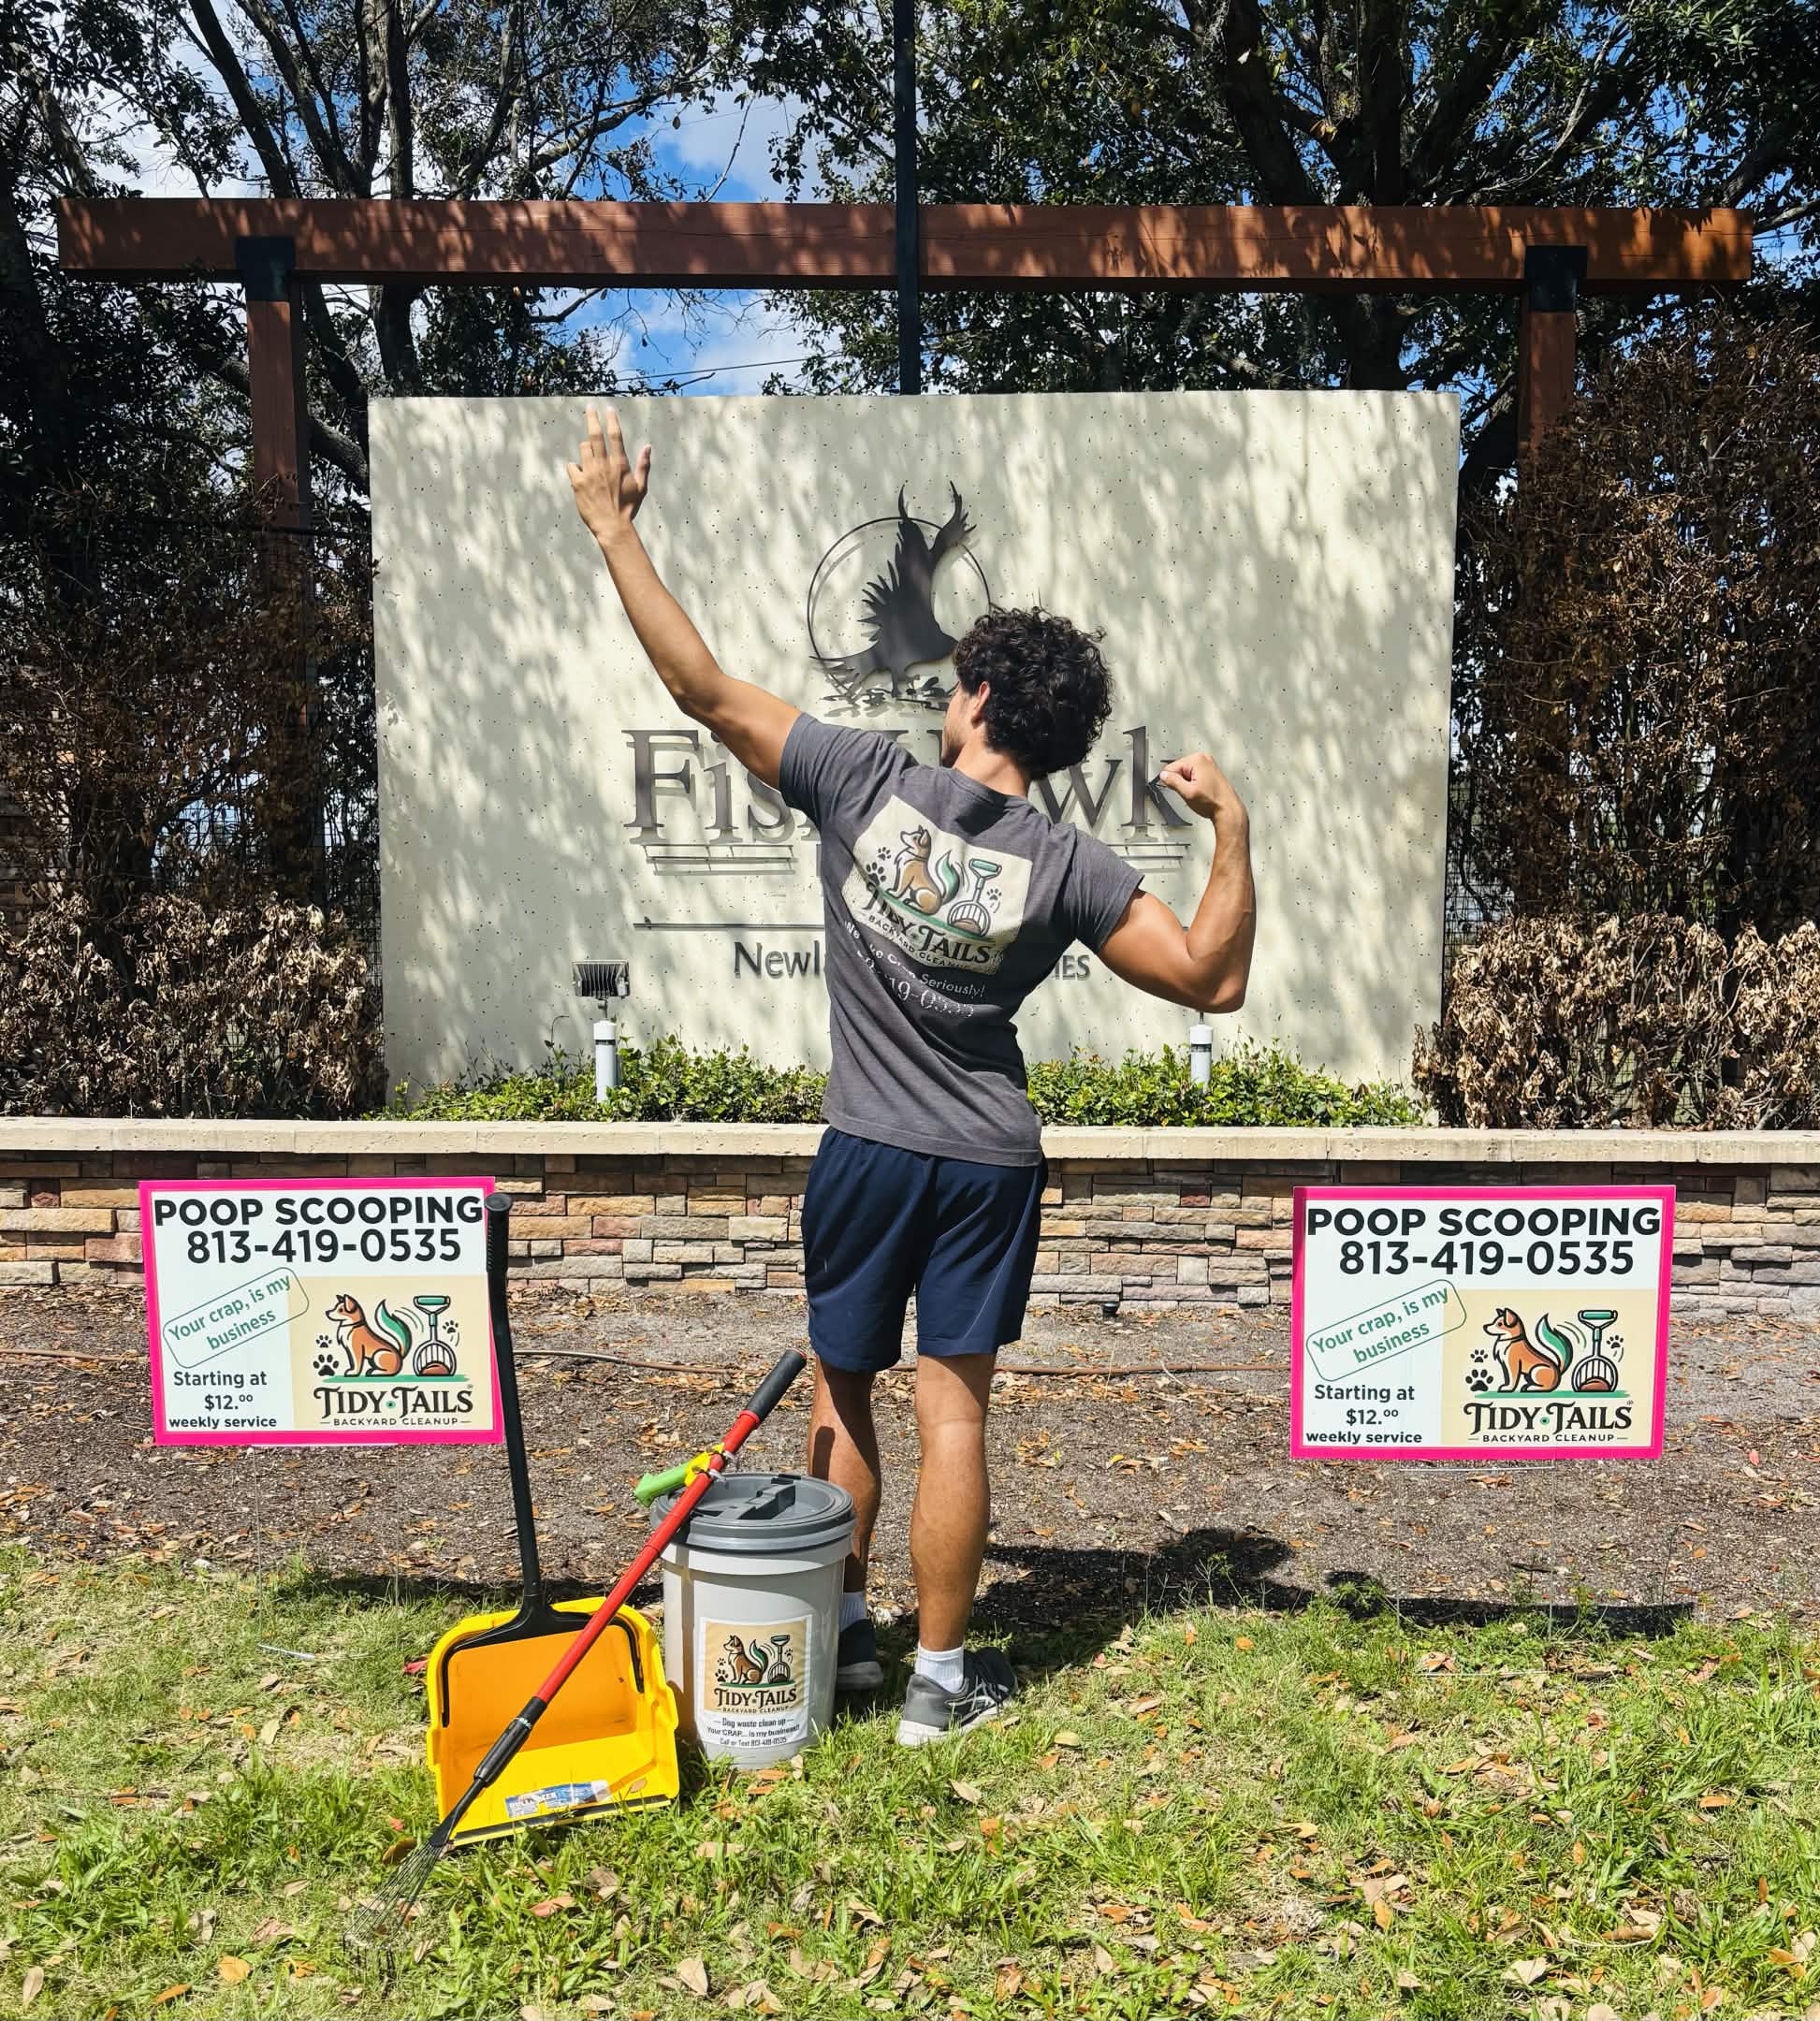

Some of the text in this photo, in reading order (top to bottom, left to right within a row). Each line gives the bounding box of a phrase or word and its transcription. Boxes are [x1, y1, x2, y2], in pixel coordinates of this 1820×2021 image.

[919, 924, 991, 963] TAILS
[921, 973, 985, 999] Seriously!
[154, 1196, 483, 1227] POOP SCOOPING
[1307, 1207, 1660, 1236] POOP SCOOPING
[187, 1229, 461, 1263] 813-419-0535
[1340, 1241, 1634, 1275] 813-419-0535
[168, 1275, 291, 1341] Your crap, is my
[1312, 1287, 1449, 1353] Your crap, is my
[207, 1310, 276, 1349] business
[1353, 1323, 1430, 1363] business
[174, 1371, 268, 1389] Starting at
[1315, 1384, 1415, 1403] Starting at
[313, 1386, 473, 1418] TIDY TAILS
[168, 1416, 277, 1430] weekly service
[1463, 1402, 1632, 1435] TIDY TAILS
[1306, 1431, 1422, 1445] weekly service
[714, 1688, 797, 1708] TIDY TAILS
[722, 1718, 735, 1728] Dog
